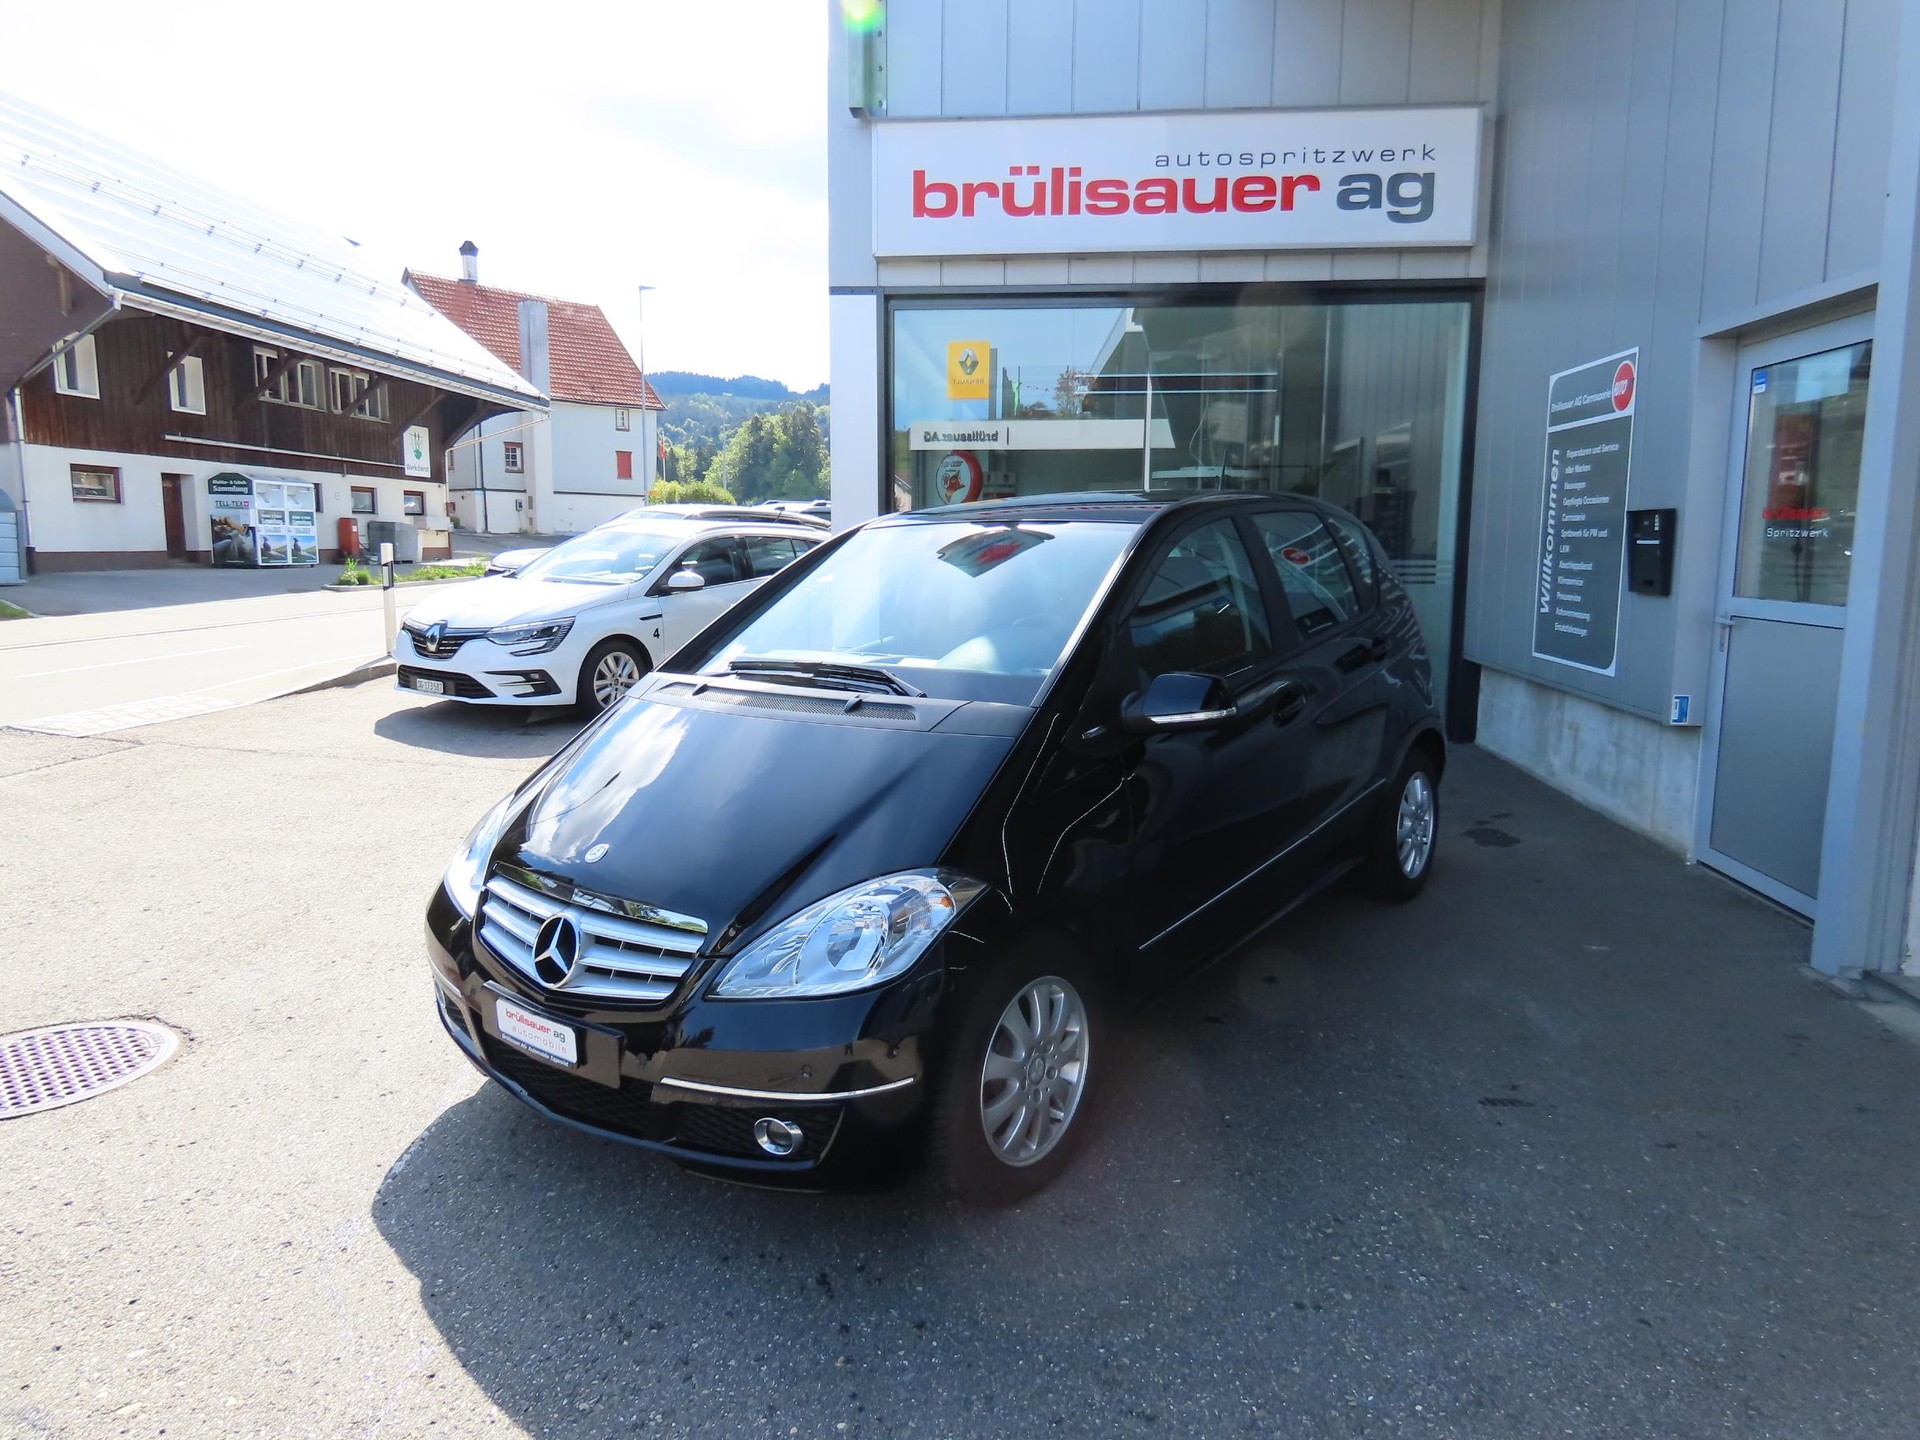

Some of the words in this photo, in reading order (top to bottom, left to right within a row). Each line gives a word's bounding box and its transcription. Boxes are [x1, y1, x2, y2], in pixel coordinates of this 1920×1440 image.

[1155, 143, 1436, 168] autospritzwerk
[912, 165, 1320, 218] brülisauer
[1336, 172, 1436, 224] ag
[1574, 396, 1583, 407] AG
[1592, 446, 1601, 454] und
[1601, 442, 1619, 453] Service
[212, 485, 248, 493] Sammlung
[1540, 449, 1560, 613] Willkommen
[1766, 527, 1829, 539] Spritzwerk
[653, 627, 660, 639] 4
[505, 1007, 552, 1034] brülisauer
[553, 1029, 566, 1044] ag
[511, 1025, 567, 1054] automobile
